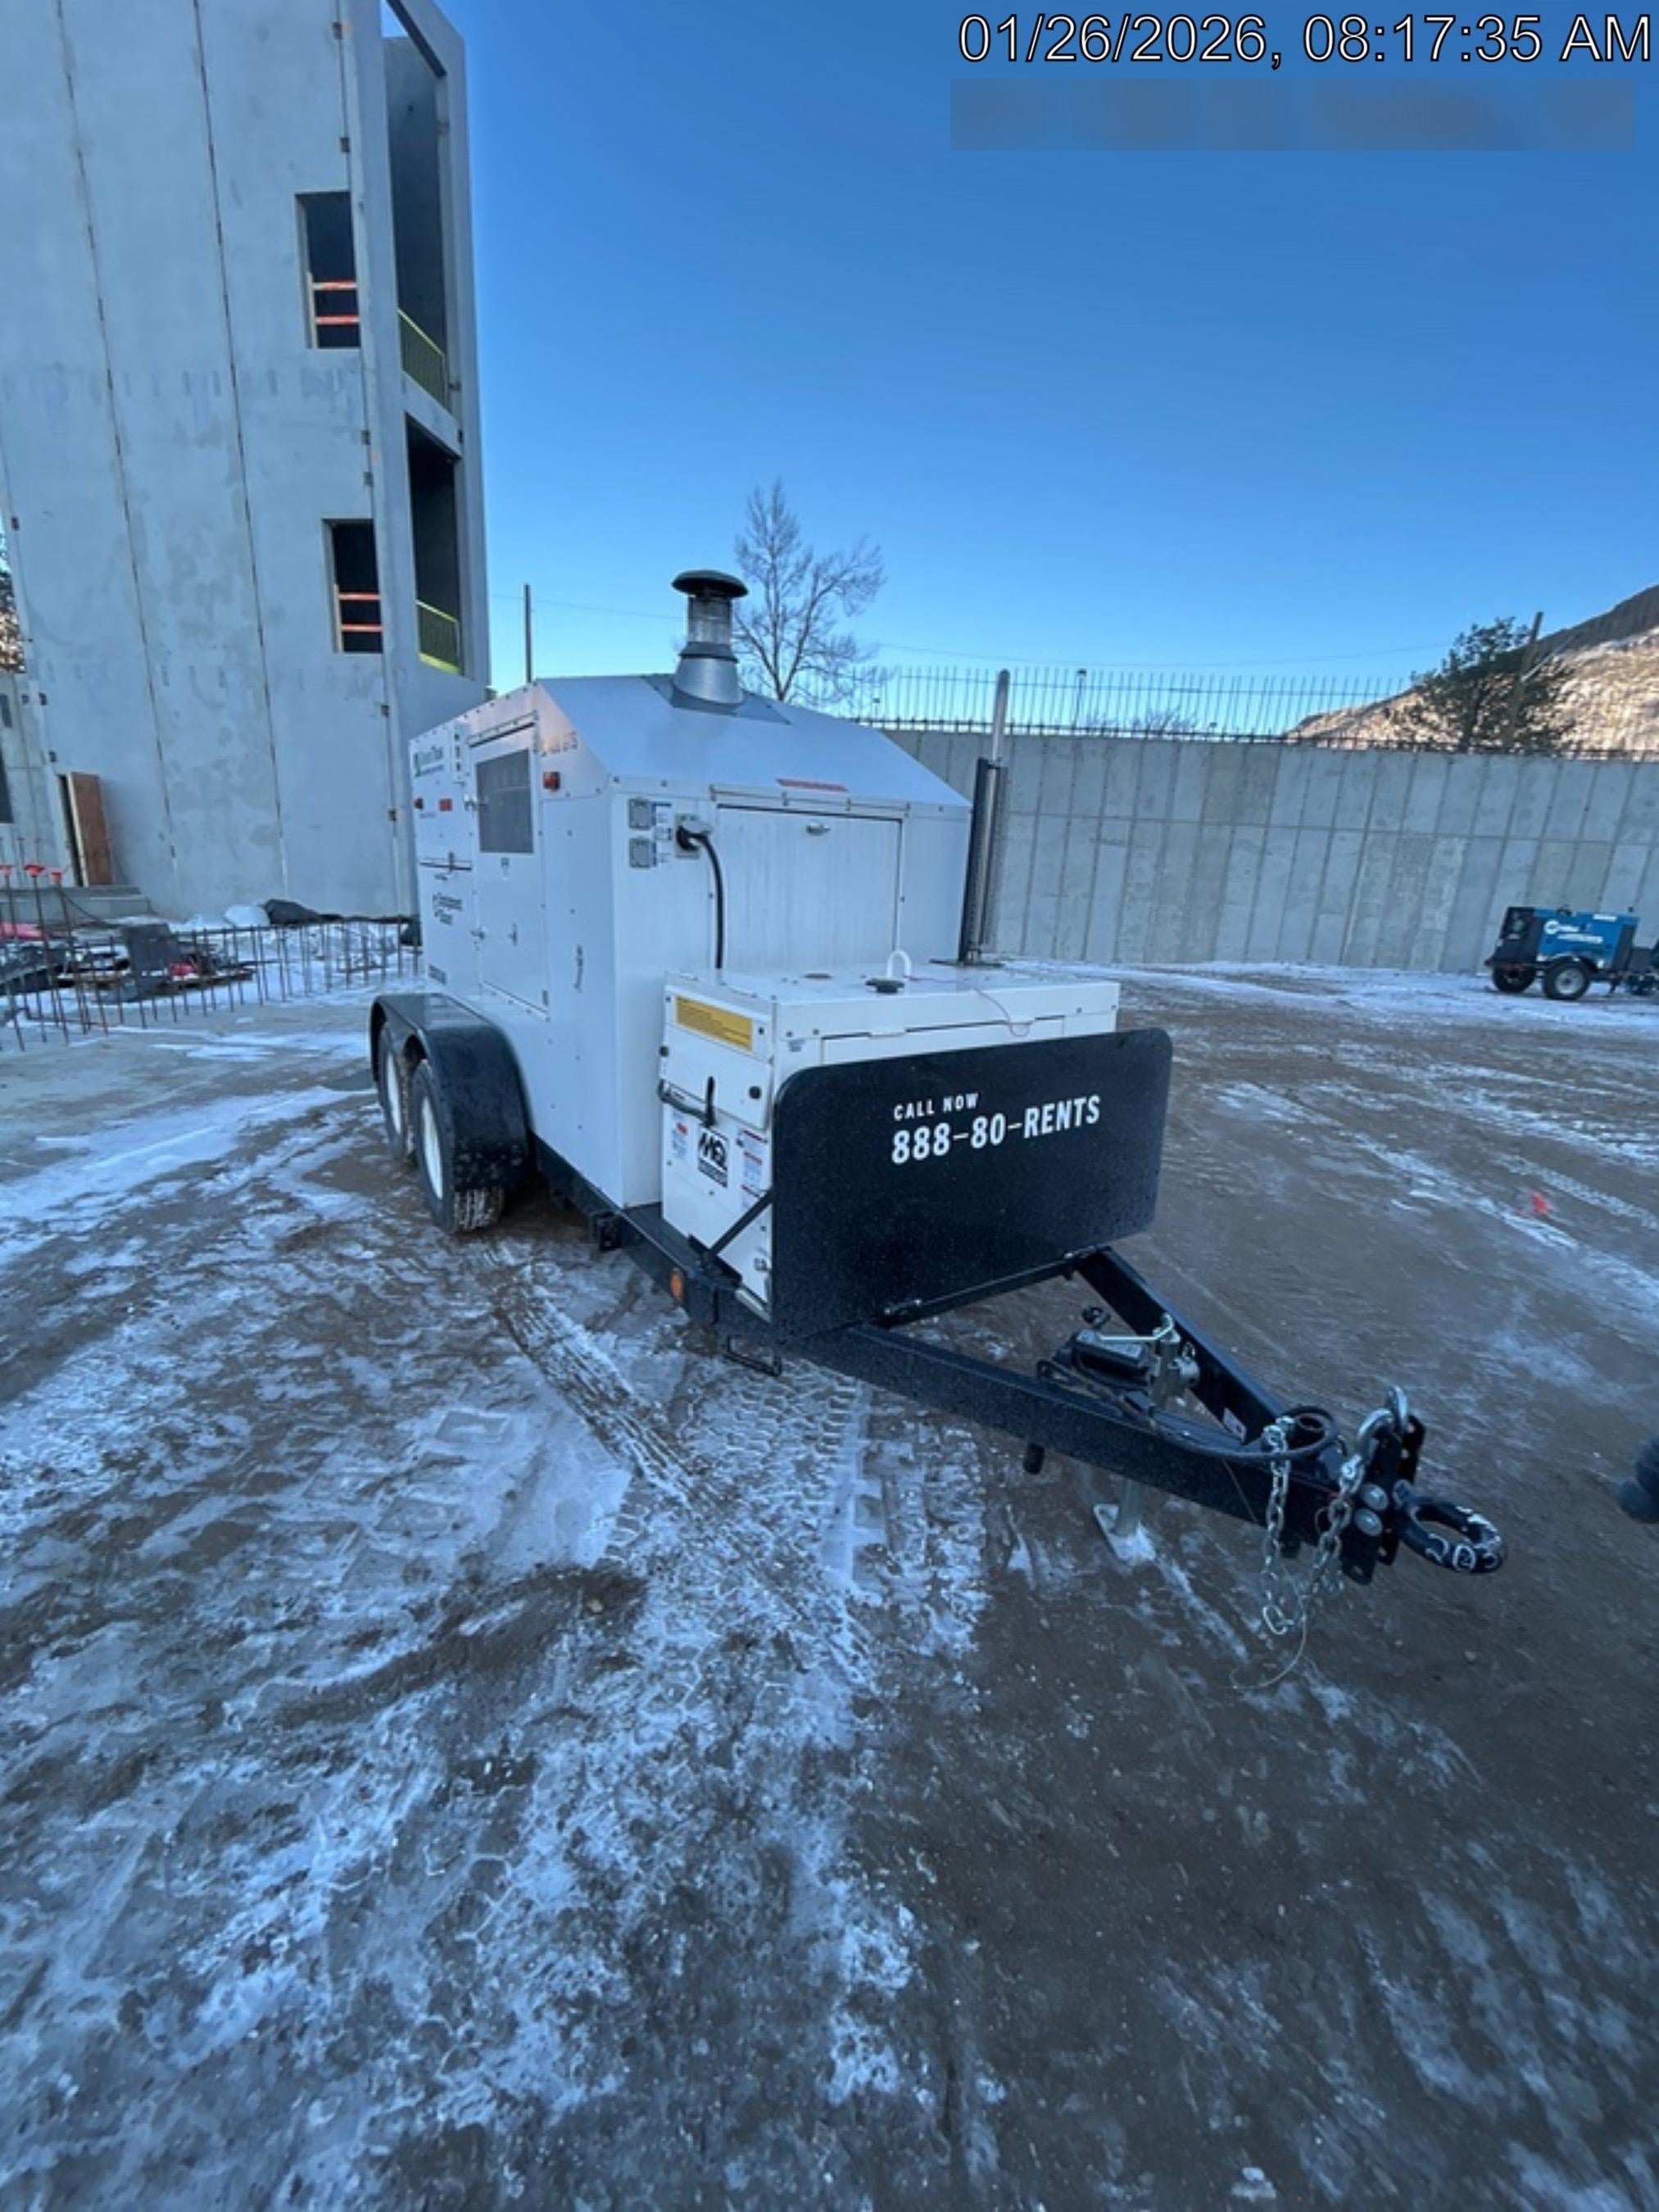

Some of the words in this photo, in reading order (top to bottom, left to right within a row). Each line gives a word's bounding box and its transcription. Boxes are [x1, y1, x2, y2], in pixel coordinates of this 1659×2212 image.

[891, 1095, 1101, 1164] 888-80-RENTS
[893, 1099, 935, 1122] CALL
[942, 1092, 980, 1113] NOW
